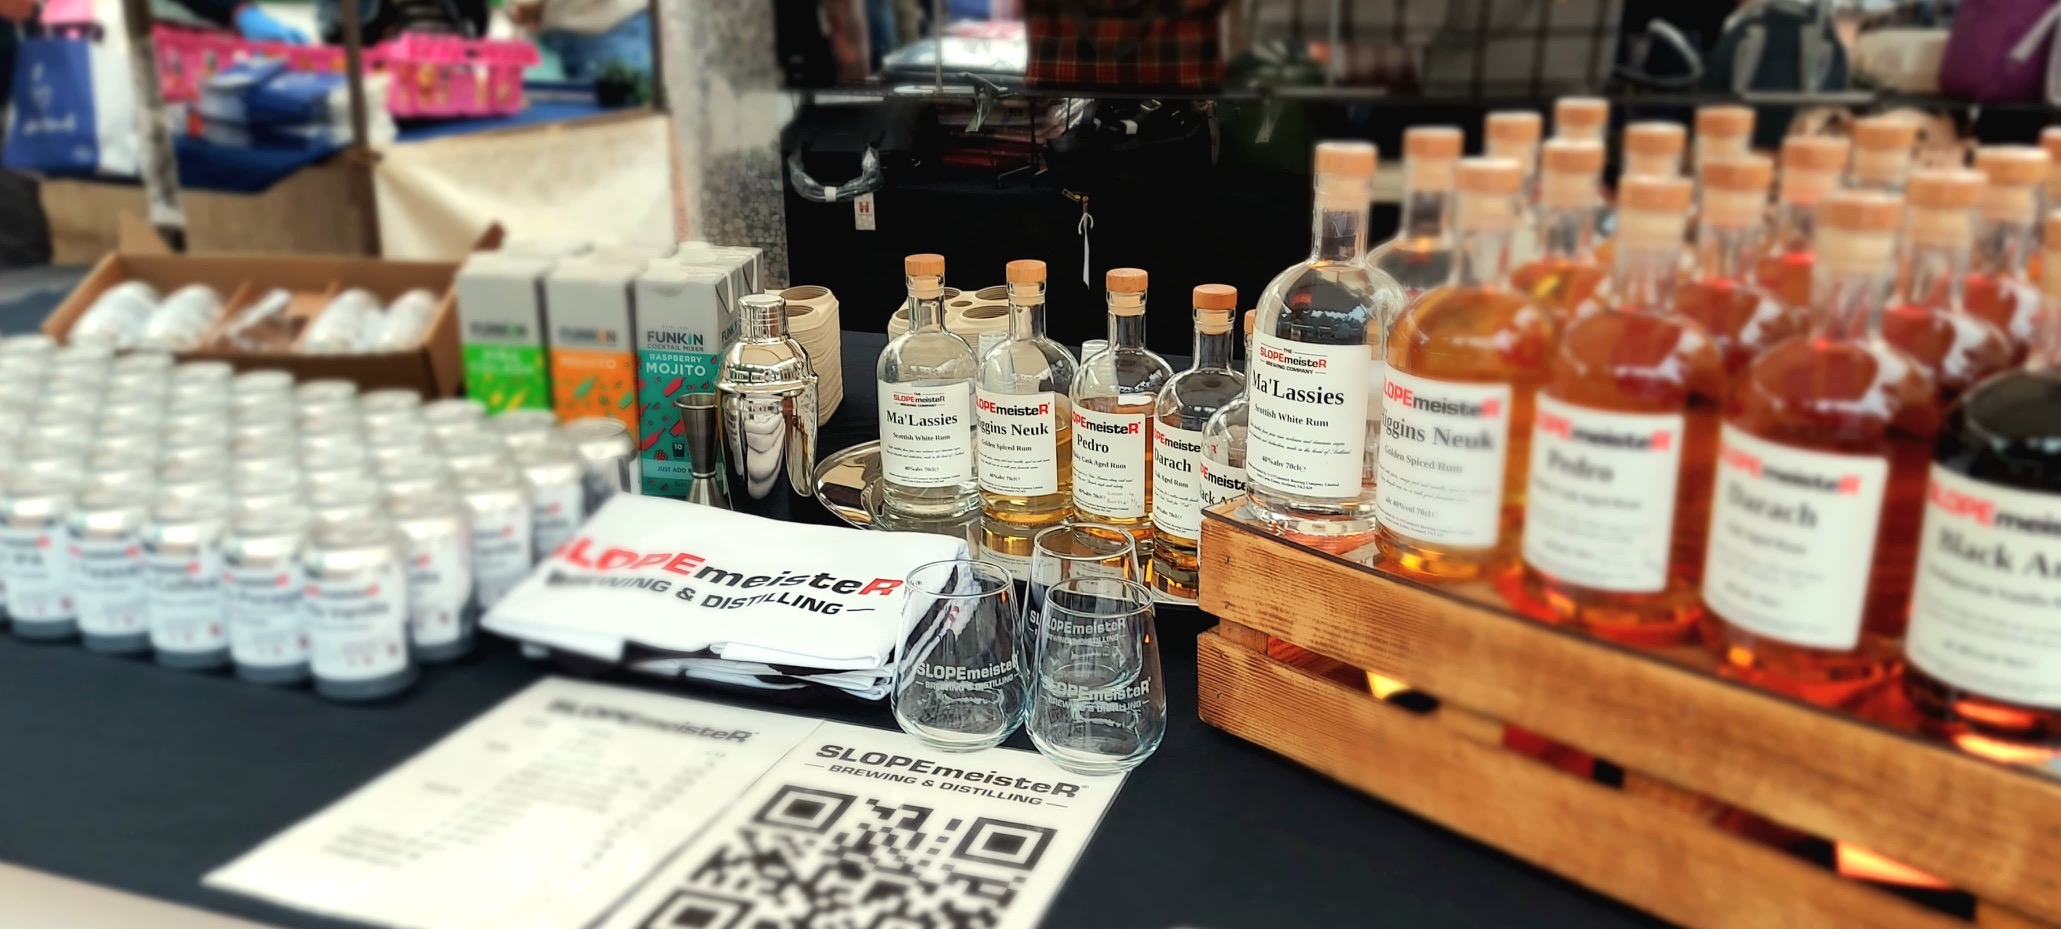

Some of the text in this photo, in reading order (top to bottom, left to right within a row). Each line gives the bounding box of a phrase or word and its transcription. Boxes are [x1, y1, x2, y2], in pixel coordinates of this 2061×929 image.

[647, 330, 704, 347] FUNKIN
[647, 343, 704, 353] COCKTAIL MIXER
[649, 353, 702, 363] RASPBERRY
[1260, 346, 1327, 368] SLOPEmeisteR
[645, 362, 706, 376] MOJITO
[1266, 360, 1313, 375] BREWING COMPANY
[1252, 369, 1344, 405] Ma'Lassies
[893, 394, 945, 403] SLOPEmeisteR
[887, 410, 958, 427] Ma'Lassies
[1254, 403, 1329, 427] Scottish White Rum
[893, 432, 914, 441] Scottish
[1011, 422, 1049, 436] Neuk
[1077, 433, 1109, 453] Pedro
[1432, 426, 1495, 451] Neuk
[674, 443, 683, 451] 10
[996, 443, 1014, 451] Spiced
[1094, 460, 1109, 469] Aged
[1154, 447, 1191, 473] Darach
[1385, 445, 1463, 473] Golden Spiced Rum
[1174, 479, 1189, 488] Rum
[675, 587, 696, 601] &
[700, 591, 843, 615] DISTILLING
[828, 764, 1043, 806] BREWING & DISTILLING
